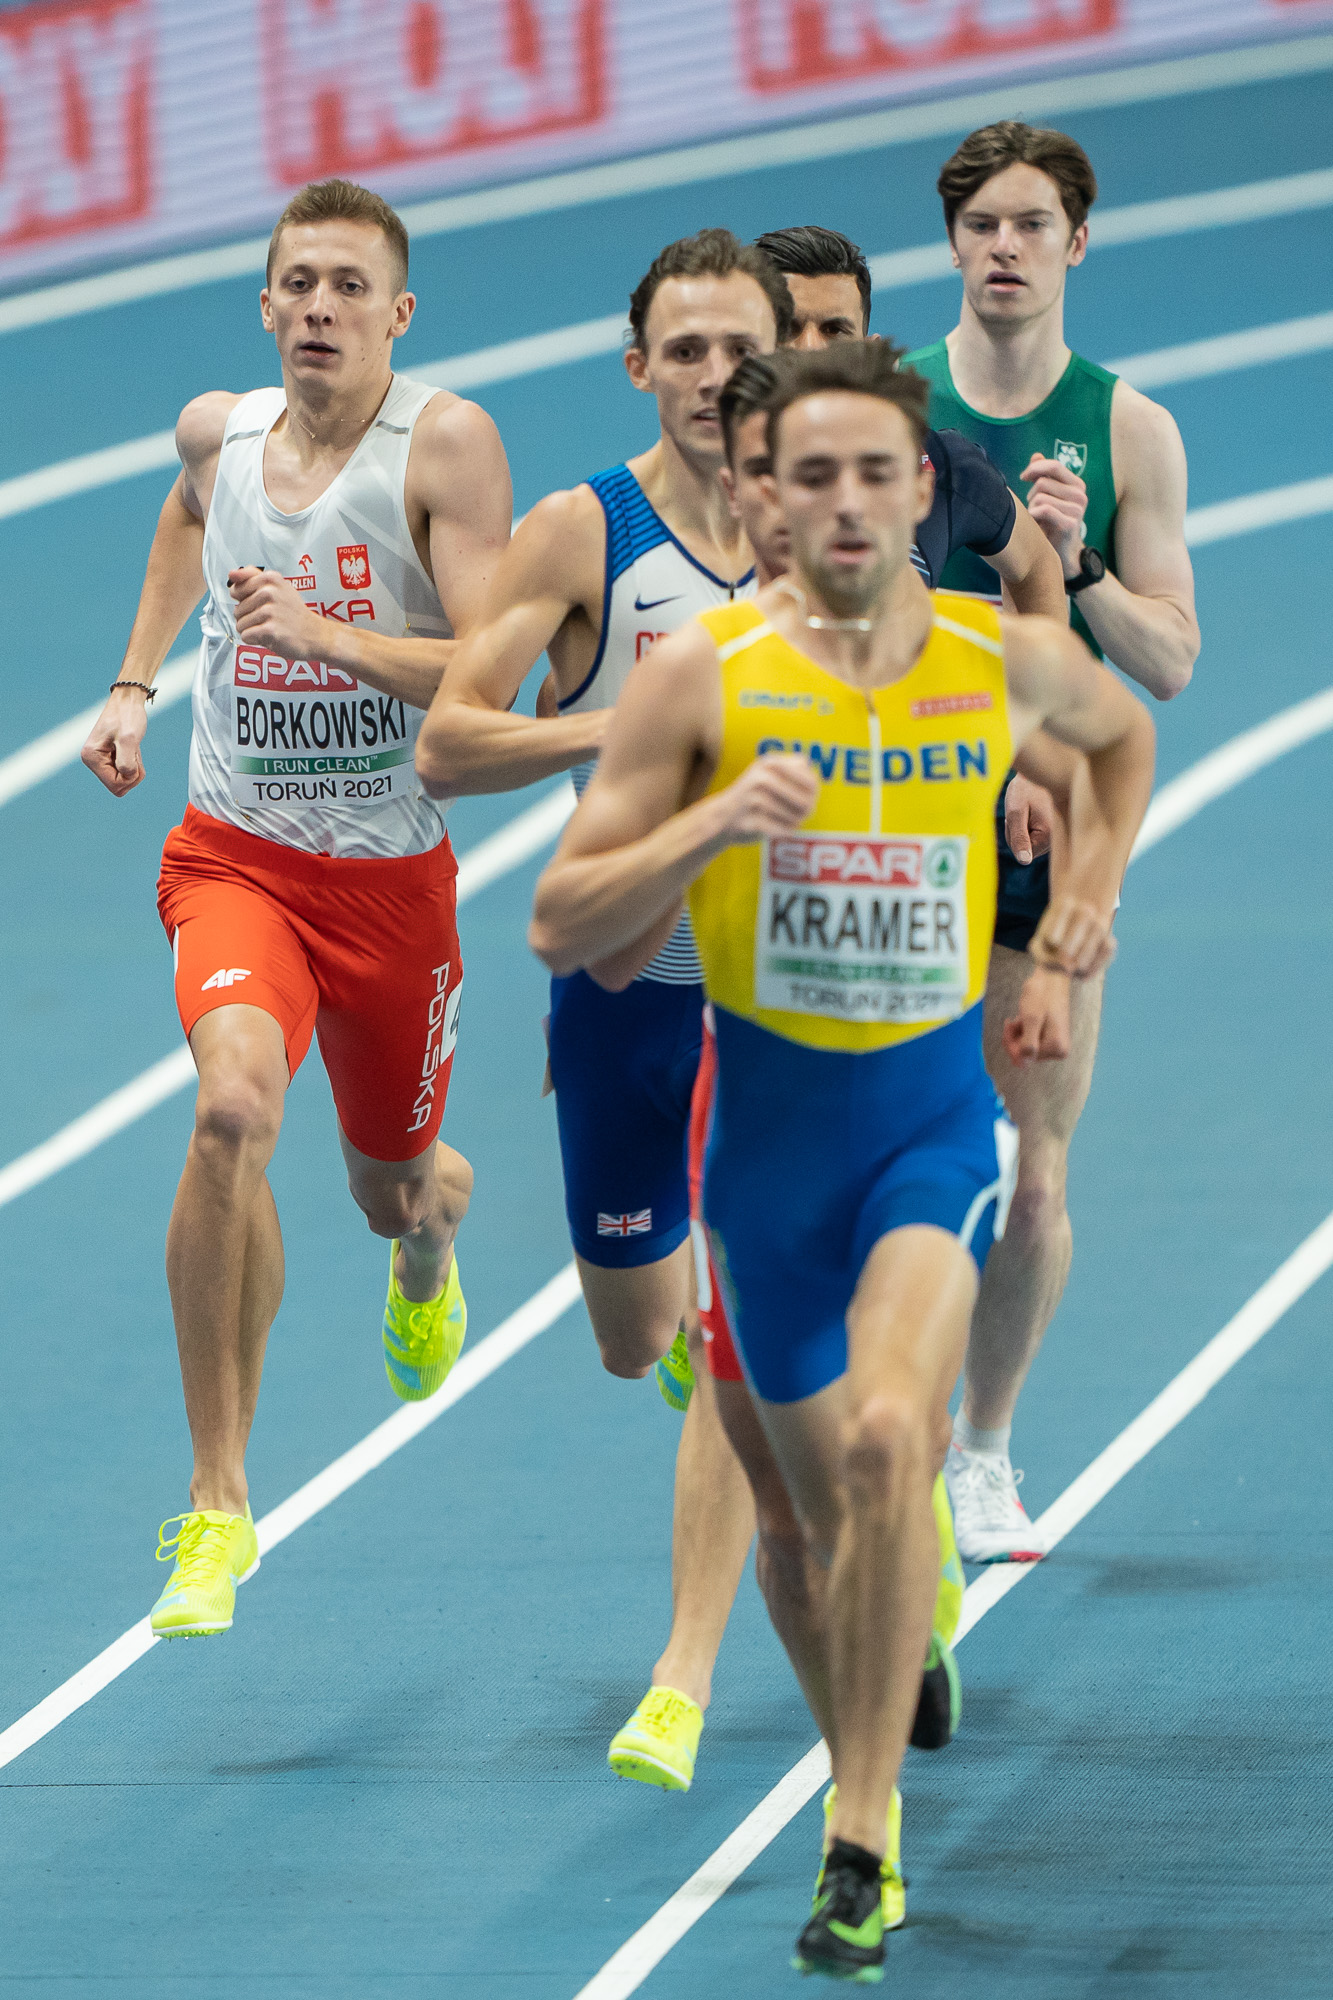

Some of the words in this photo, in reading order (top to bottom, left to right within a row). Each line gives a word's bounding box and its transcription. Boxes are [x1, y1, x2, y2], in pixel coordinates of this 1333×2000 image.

[339, 546, 366, 555] POLSKA
[289, 576, 314, 589] RLEN
[237, 651, 354, 687] SPAR
[236, 696, 407, 750] BORKOWSKI
[264, 761, 269, 773] I
[273, 760, 310, 773] RUN
[253, 777, 338, 801] TORUŃ
[343, 774, 392, 799] 2021
[773, 841, 920, 882] SPAR
[769, 891, 958, 953] KRAMER
[407, 960, 451, 1133] POLSKA
